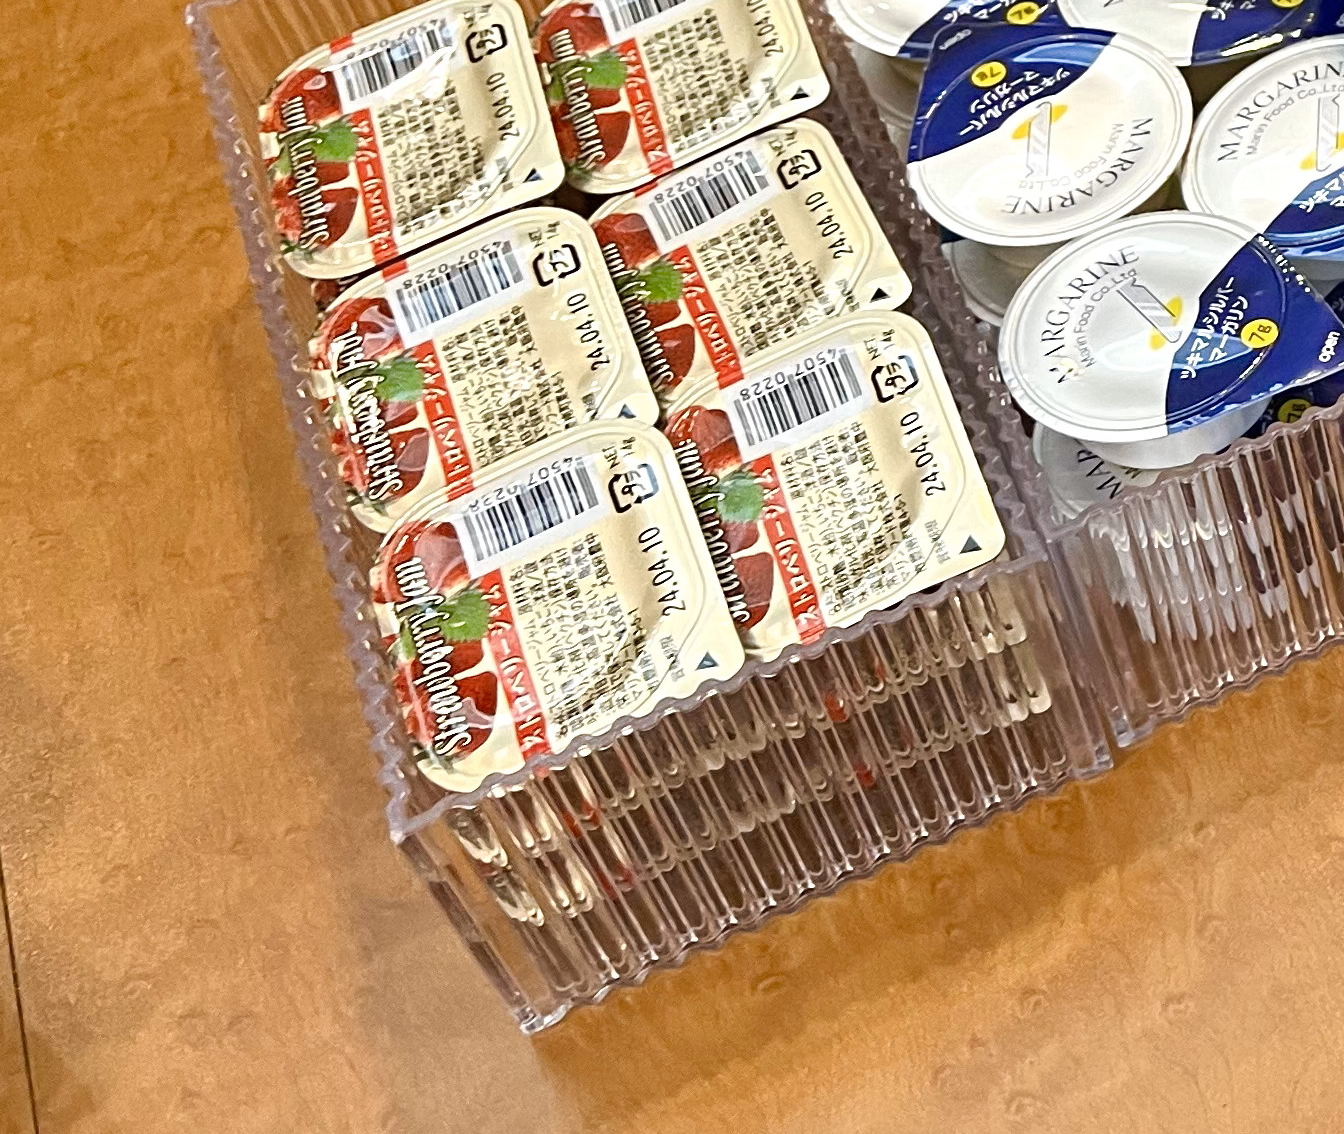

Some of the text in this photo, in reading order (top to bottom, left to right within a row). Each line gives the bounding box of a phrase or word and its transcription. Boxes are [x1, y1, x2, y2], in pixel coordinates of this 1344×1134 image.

[486, 72, 520, 142] 24.04.10
[549, 29, 605, 169] Strawberry Jam
[1264, 96, 1295, 122] Food
[278, 96, 330, 250] Strawberry Jam
[654, 150, 744, 204] 4507 0228
[1000, 116, 1154, 215] MARGARINE
[805, 191, 854, 259] 24.04.10
[402, 264, 449, 289] 0228
[567, 292, 610, 371] 24.04.10
[864, 338, 881, 360] NET
[881, 329, 896, 352] 14g
[1073, 304, 1095, 333] Food
[1180, 276, 1236, 379] ツキマルシルバー
[1209, 295, 1248, 362] マーガリン
[1318, 331, 1341, 362] open
[740, 347, 840, 402] 4507 0228
[603, 445, 619, 470] NET
[621, 434, 636, 458] 14g
[900, 411, 946, 496] 24.04.10
[638, 527, 686, 617] 24.04.10
[754, 467, 820, 622] ストロベリージャム
[393, 557, 471, 755] Strawberry Jam
[482, 584, 545, 751] ストロベリージャム
